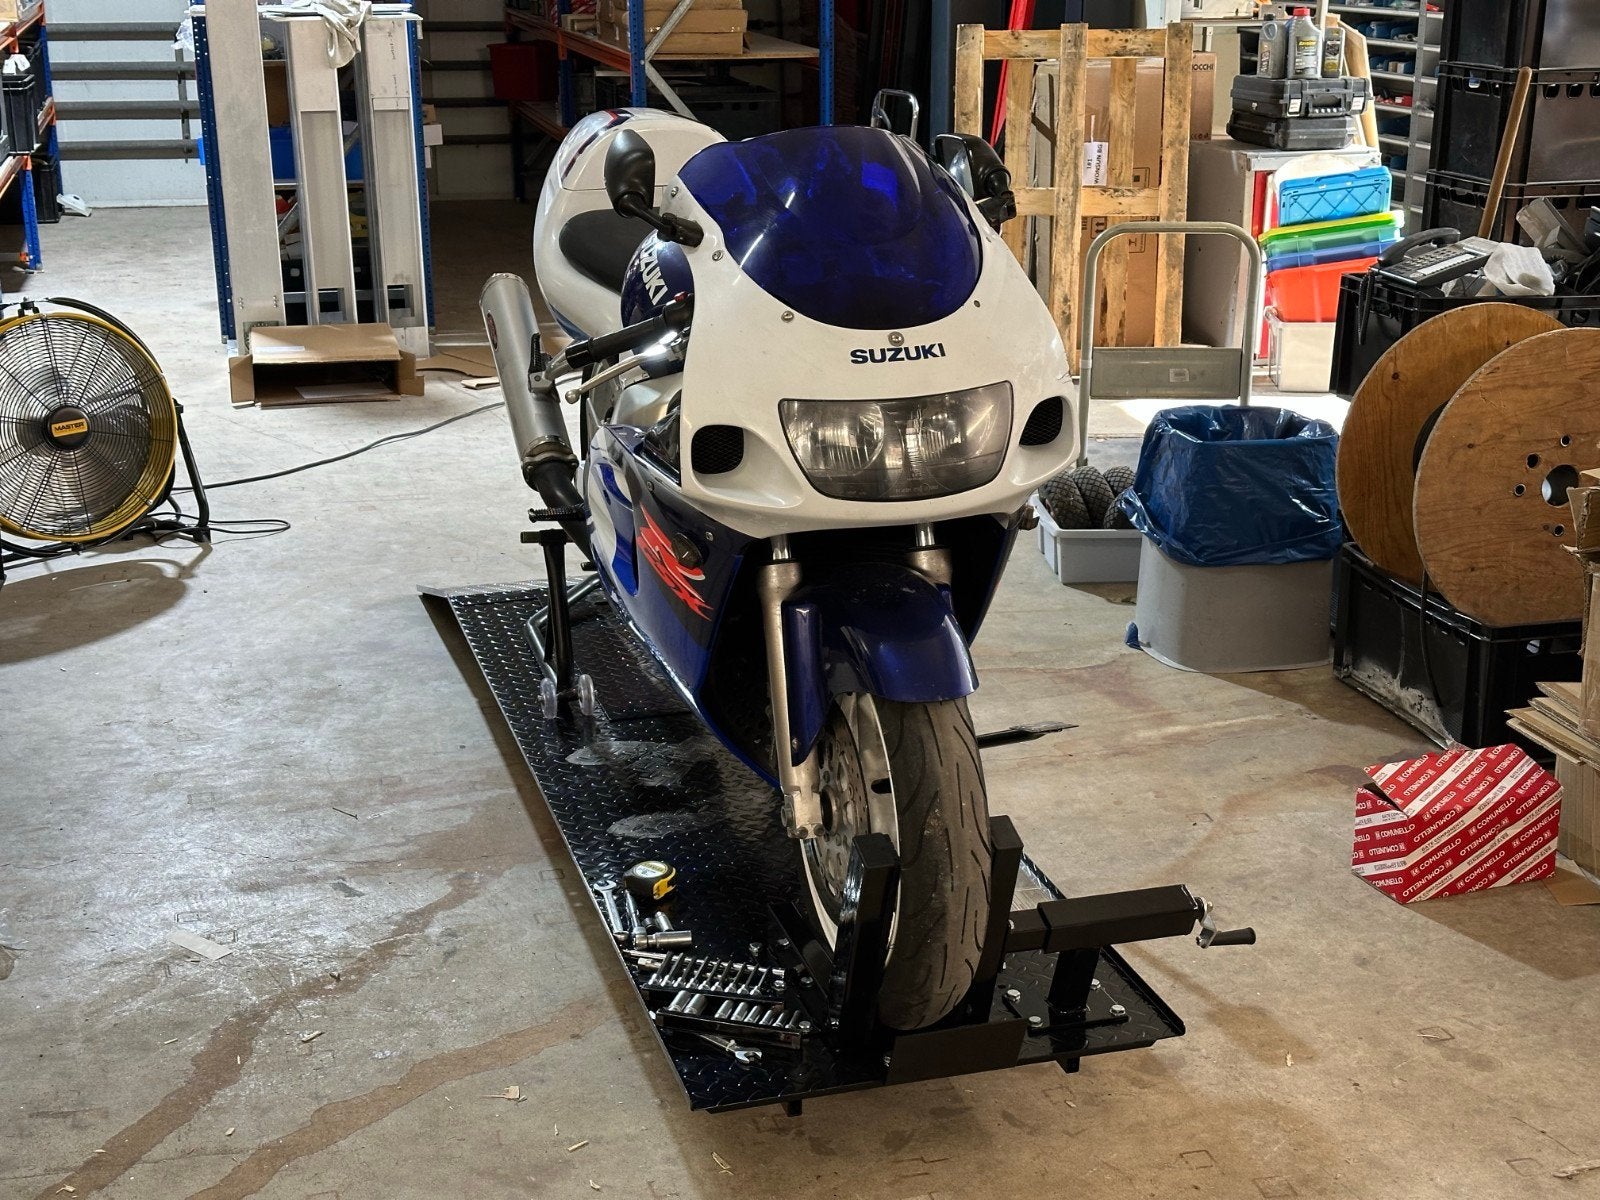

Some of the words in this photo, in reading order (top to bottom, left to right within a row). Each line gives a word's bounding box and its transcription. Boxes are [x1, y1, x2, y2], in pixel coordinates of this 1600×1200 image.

[850, 343, 946, 364] SUZUKI
[54, 422, 85, 431] MASTER
[1430, 791, 1457, 815] COMUNELLO
[1476, 796, 1516, 829] COMUNELLO
[1515, 784, 1550, 815] COMUNELLO
[1380, 824, 1415, 838] COMUNELLO
[1413, 810, 1456, 843] COMUNELLO
[1460, 824, 1501, 856] COMUNELLO
[1520, 809, 1560, 842] COMUNELLO
[1369, 844, 1399, 856] COMUNELLO
[1419, 838, 1462, 870] COMUNELLO
[1503, 836, 1543, 869] COMUNELLO
[1402, 865, 1445, 897] COMUNELLO
[1464, 850, 1506, 883] COMUNELLO
